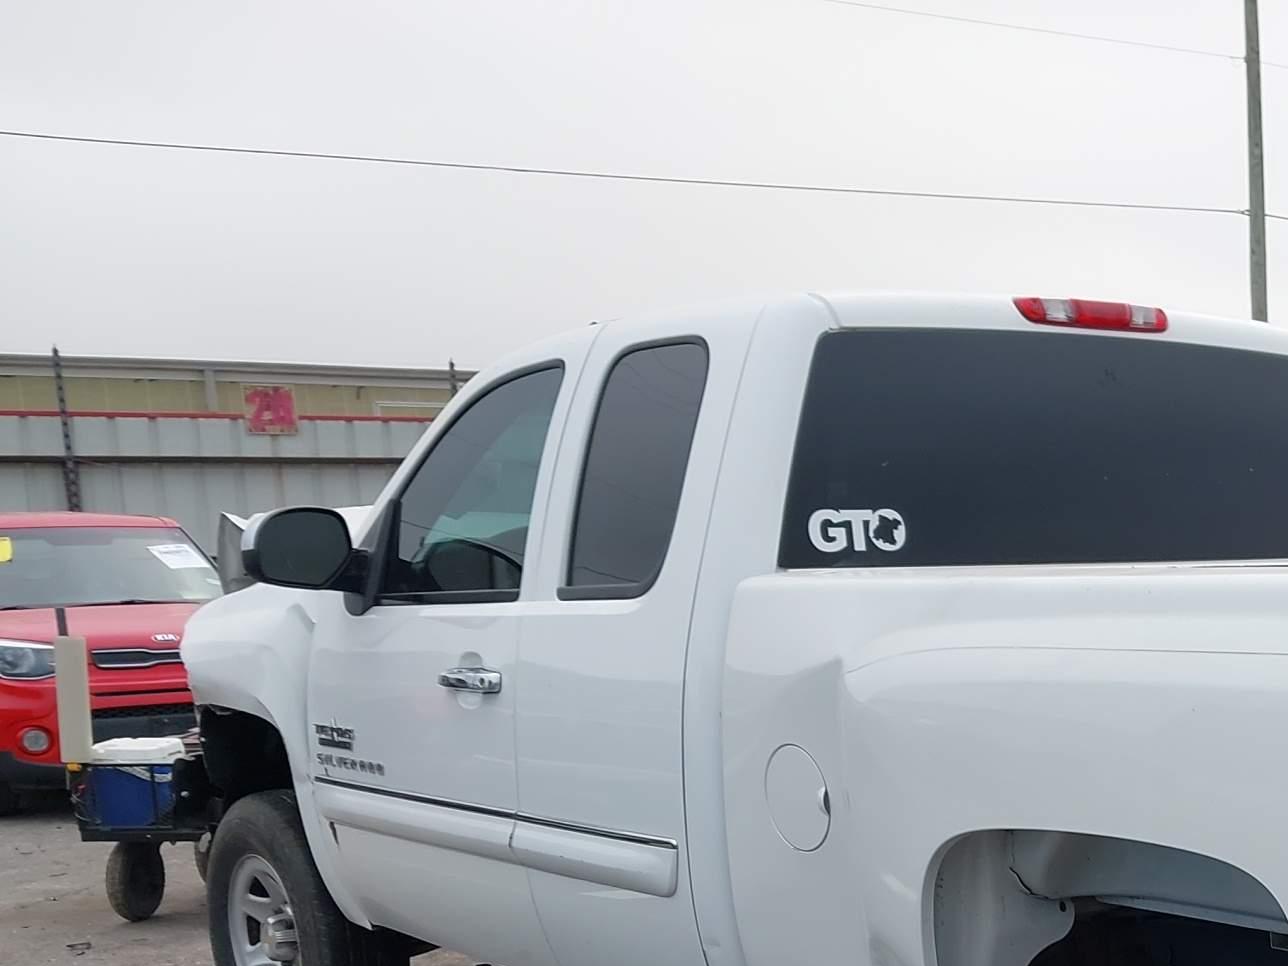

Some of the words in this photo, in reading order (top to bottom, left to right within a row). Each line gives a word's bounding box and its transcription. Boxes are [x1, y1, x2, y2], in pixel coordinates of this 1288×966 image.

[808, 509, 906, 552] GTO
[153, 633, 178, 642] KIA
[316, 753, 385, 776] SILVERADO
